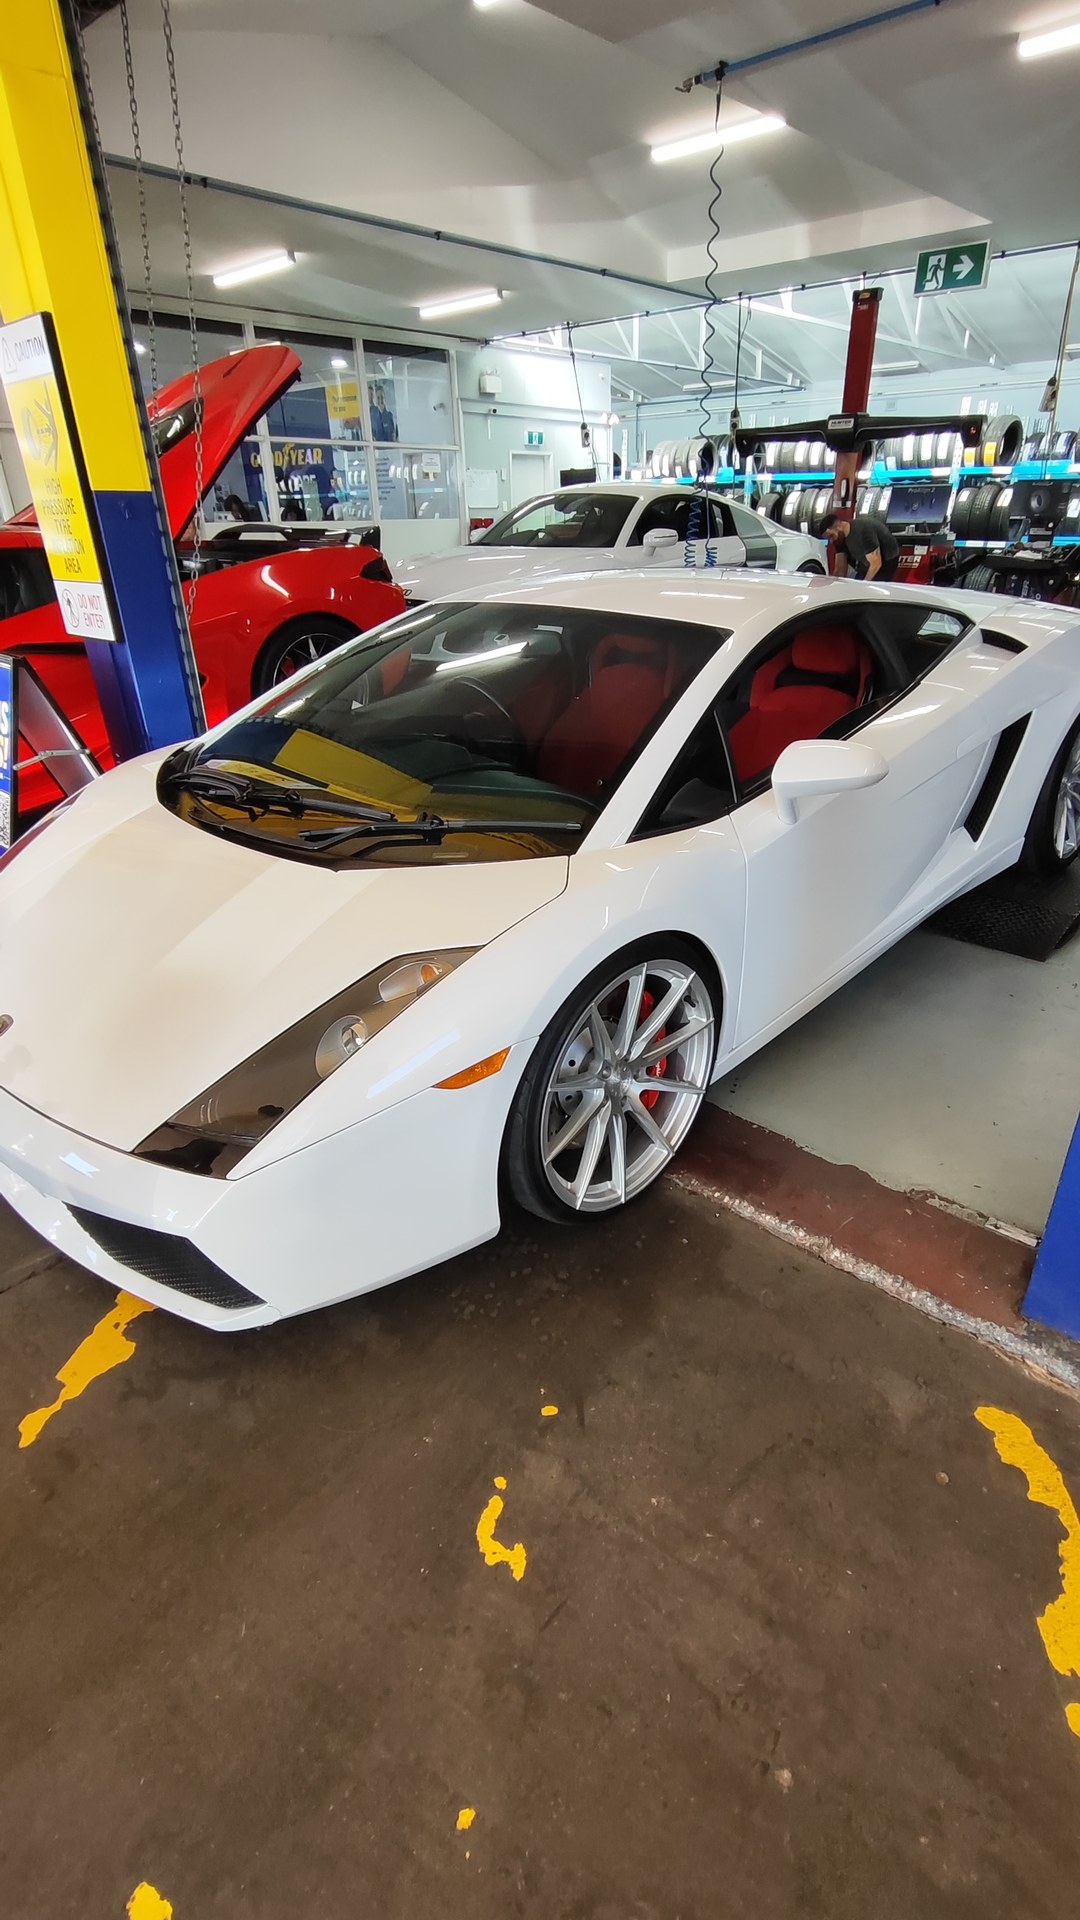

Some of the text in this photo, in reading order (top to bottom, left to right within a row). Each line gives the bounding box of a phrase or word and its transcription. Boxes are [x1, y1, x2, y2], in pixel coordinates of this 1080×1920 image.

[14, 335, 46, 361] CAUTION
[250, 447, 323, 468] GDYEAR
[44, 478, 63, 495] HIGH
[41, 497, 77, 516] PRESSURE
[54, 518, 73, 535] TYRE
[64, 557, 83, 574] AREA
[77, 593, 103, 611] DO NOT
[83, 612, 106, 630] ENTER
